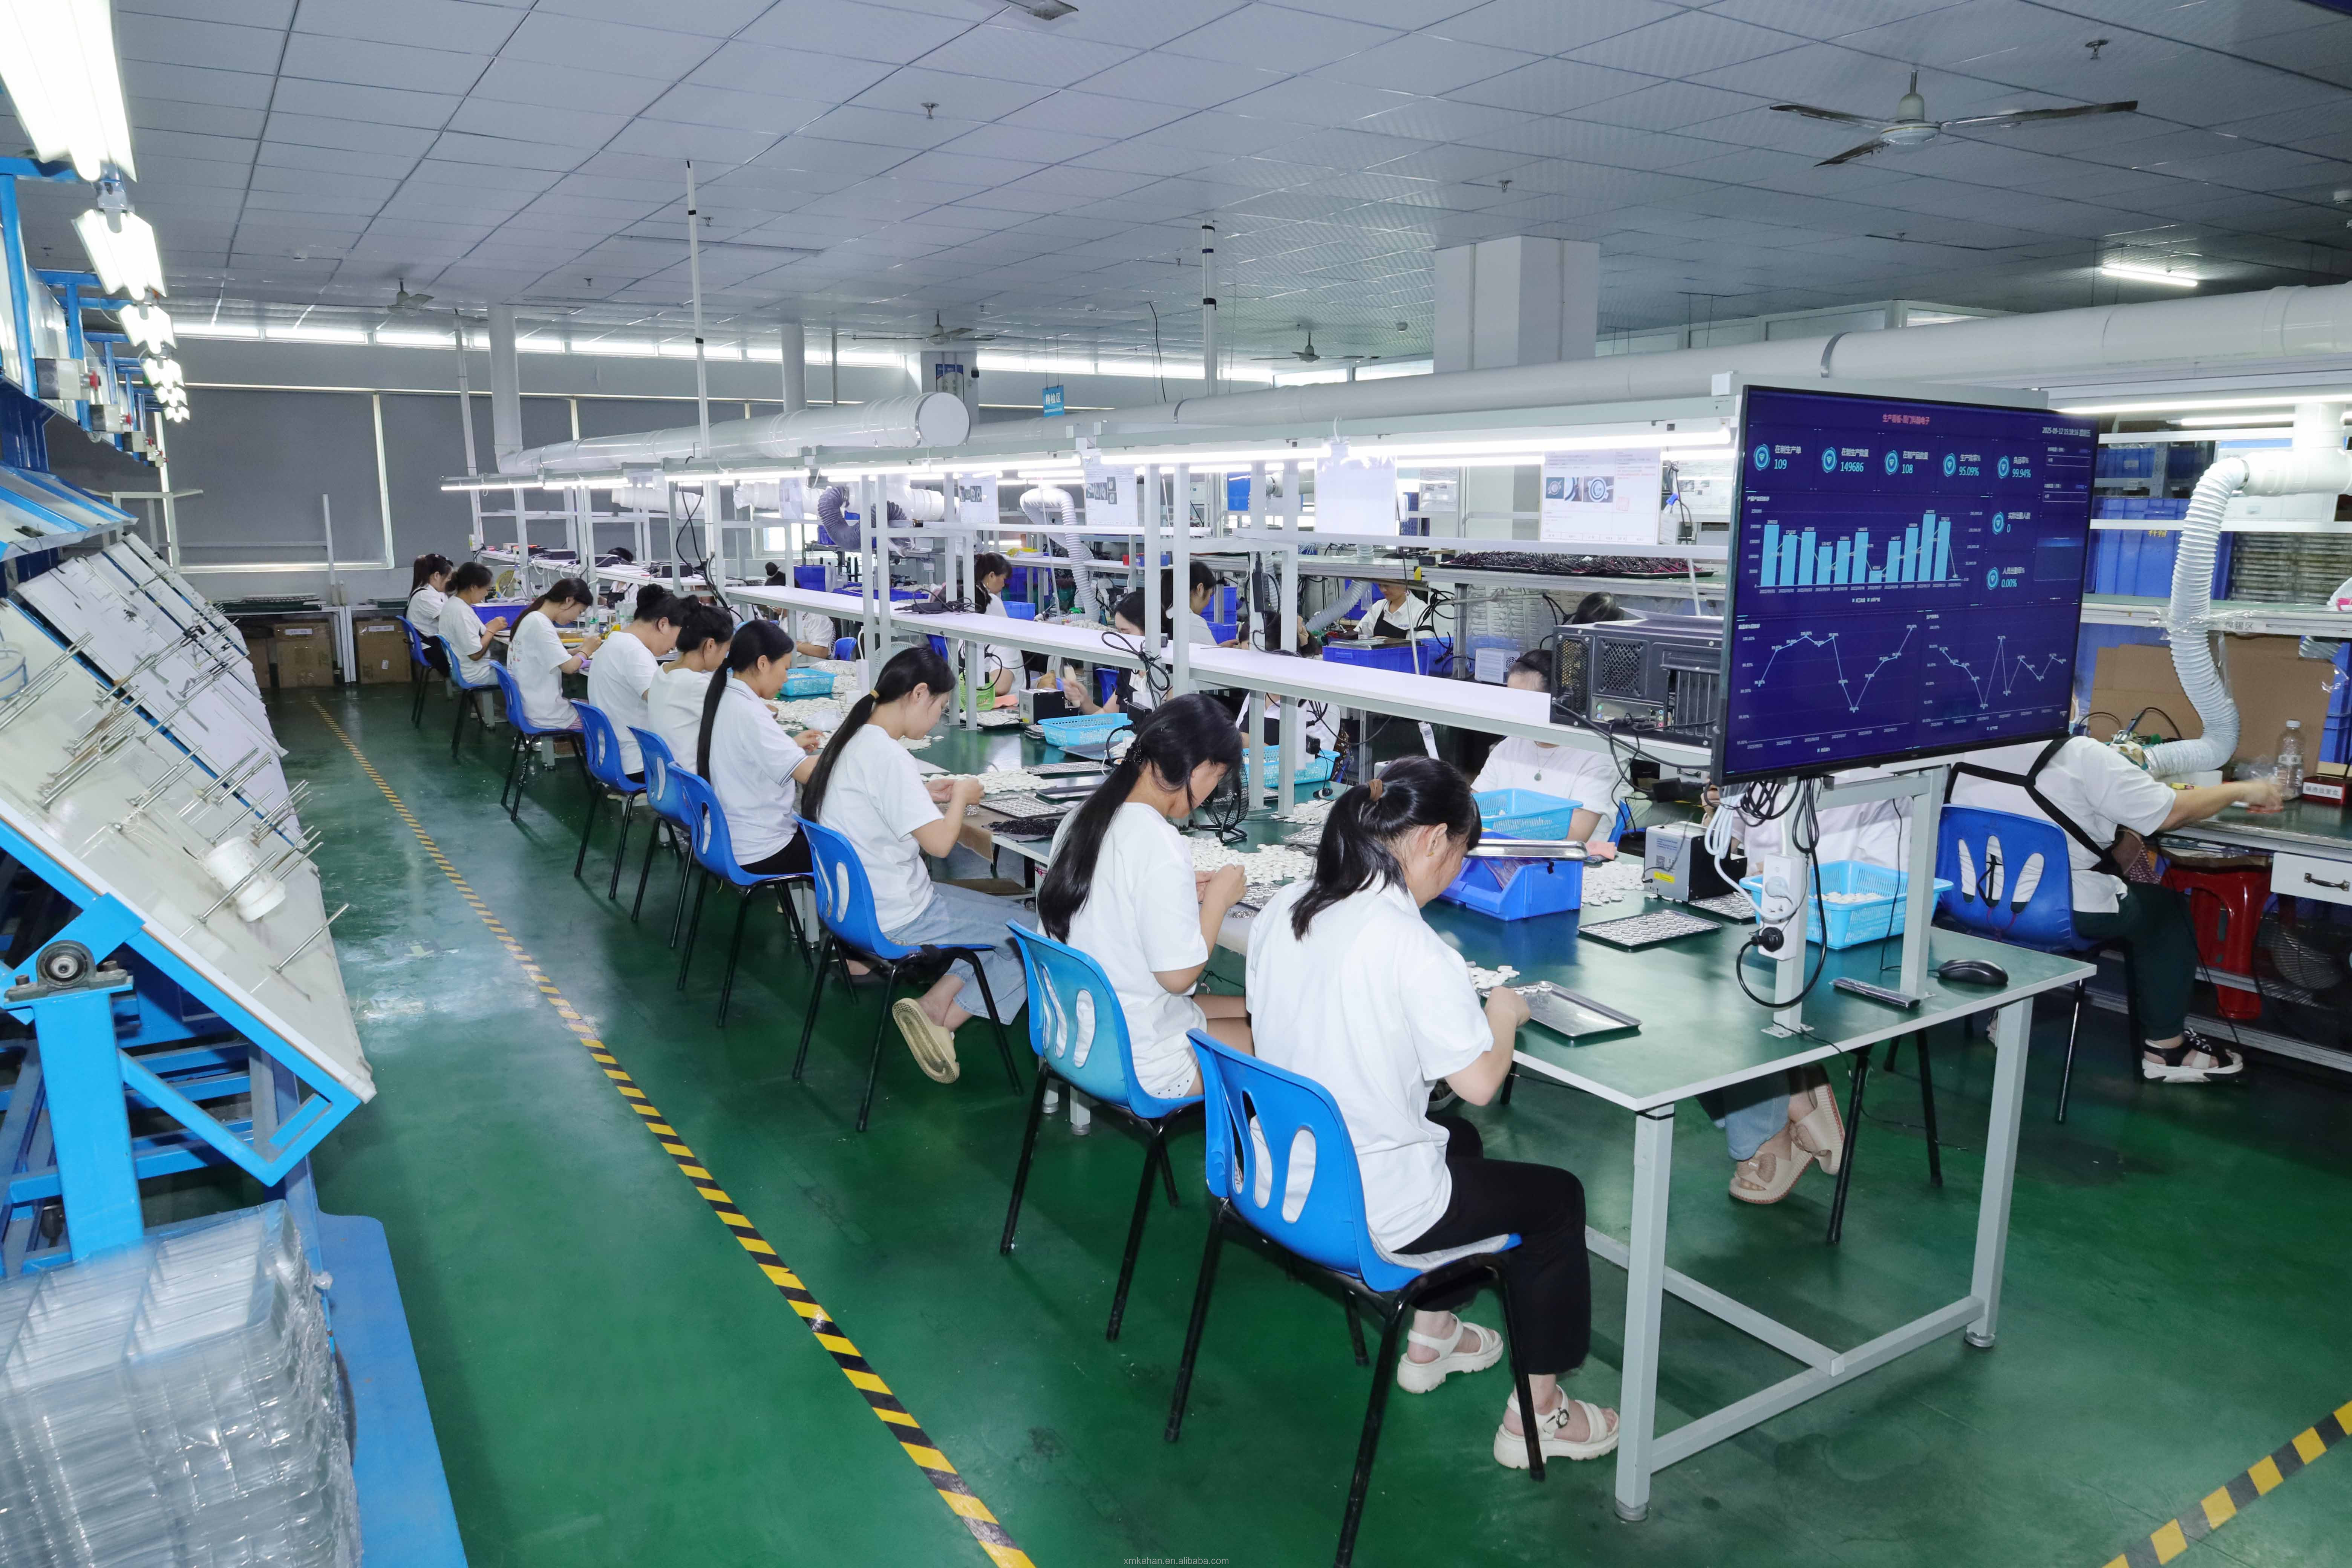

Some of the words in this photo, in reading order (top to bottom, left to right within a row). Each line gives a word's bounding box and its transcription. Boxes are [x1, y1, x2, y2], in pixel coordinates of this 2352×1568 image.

[1046, 392, 1061, 405] 待检区
[1775, 444, 1802, 454] 在制生产单
[1774, 459, 1787, 469] 109
[1840, 461, 1864, 472] 149686
[1902, 464, 1913, 474] 108
[1959, 466, 1979, 476] 95.09%
[2012, 468, 2031, 478] 99.94%
[2007, 524, 2011, 533] 0
[2001, 579, 2017, 588] 0.00%
